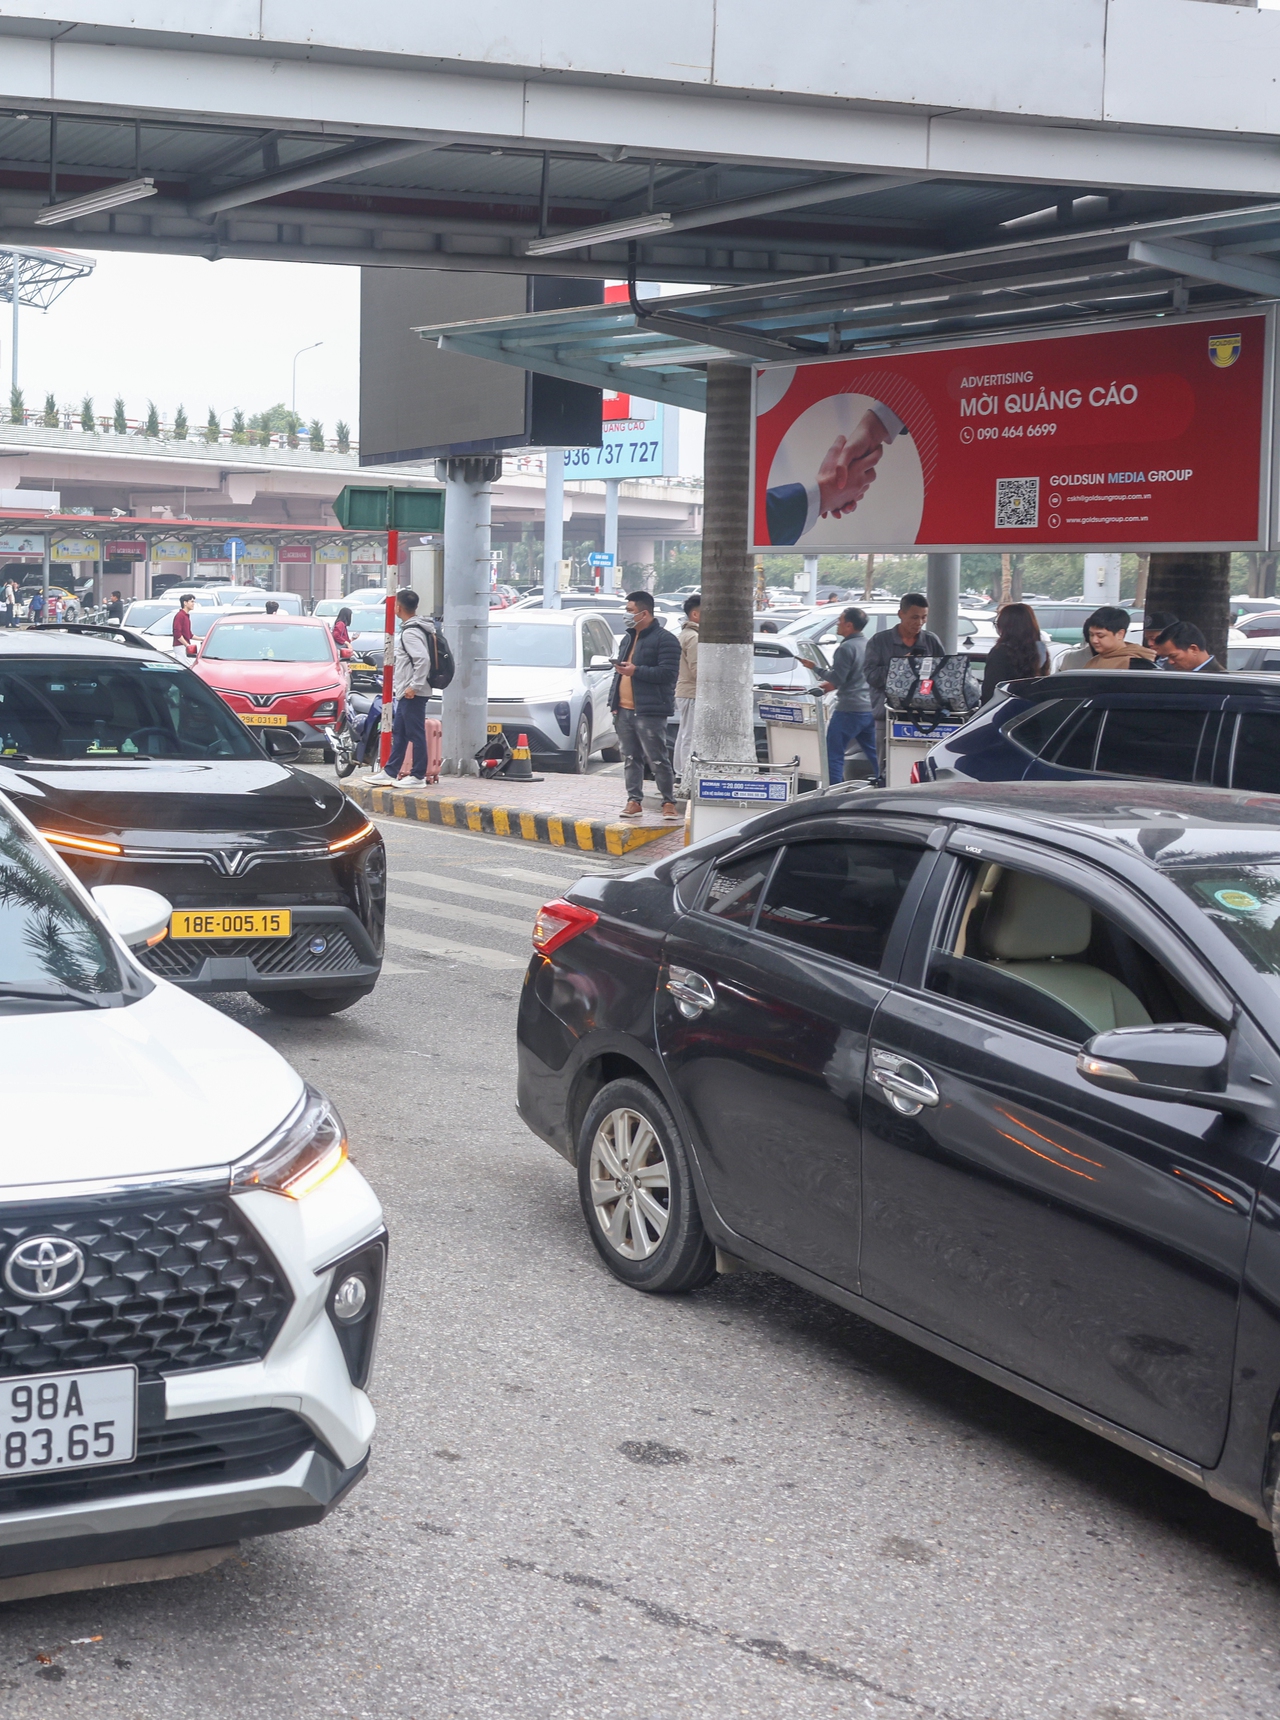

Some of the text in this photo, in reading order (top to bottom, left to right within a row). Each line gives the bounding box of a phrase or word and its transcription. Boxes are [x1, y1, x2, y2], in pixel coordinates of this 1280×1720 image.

[960, 371, 1034, 388] ADVERTISING
[960, 381, 1138, 417] MỜI QUẢNG CÁO
[977, 423, 1057, 440] 090 464 6699
[596, 443, 624, 465] 737
[630, 441, 659, 463] 727
[1050, 469, 1193, 486] GOLDSUN MEDIA GROUP
[1066, 515, 1148, 525] www.goldsungroup.com.vn
[241, 716, 282, 724] 29K-031.91
[184, 915, 280, 933] 18E-005.15
[11, 1380, 84, 1423] 98A
